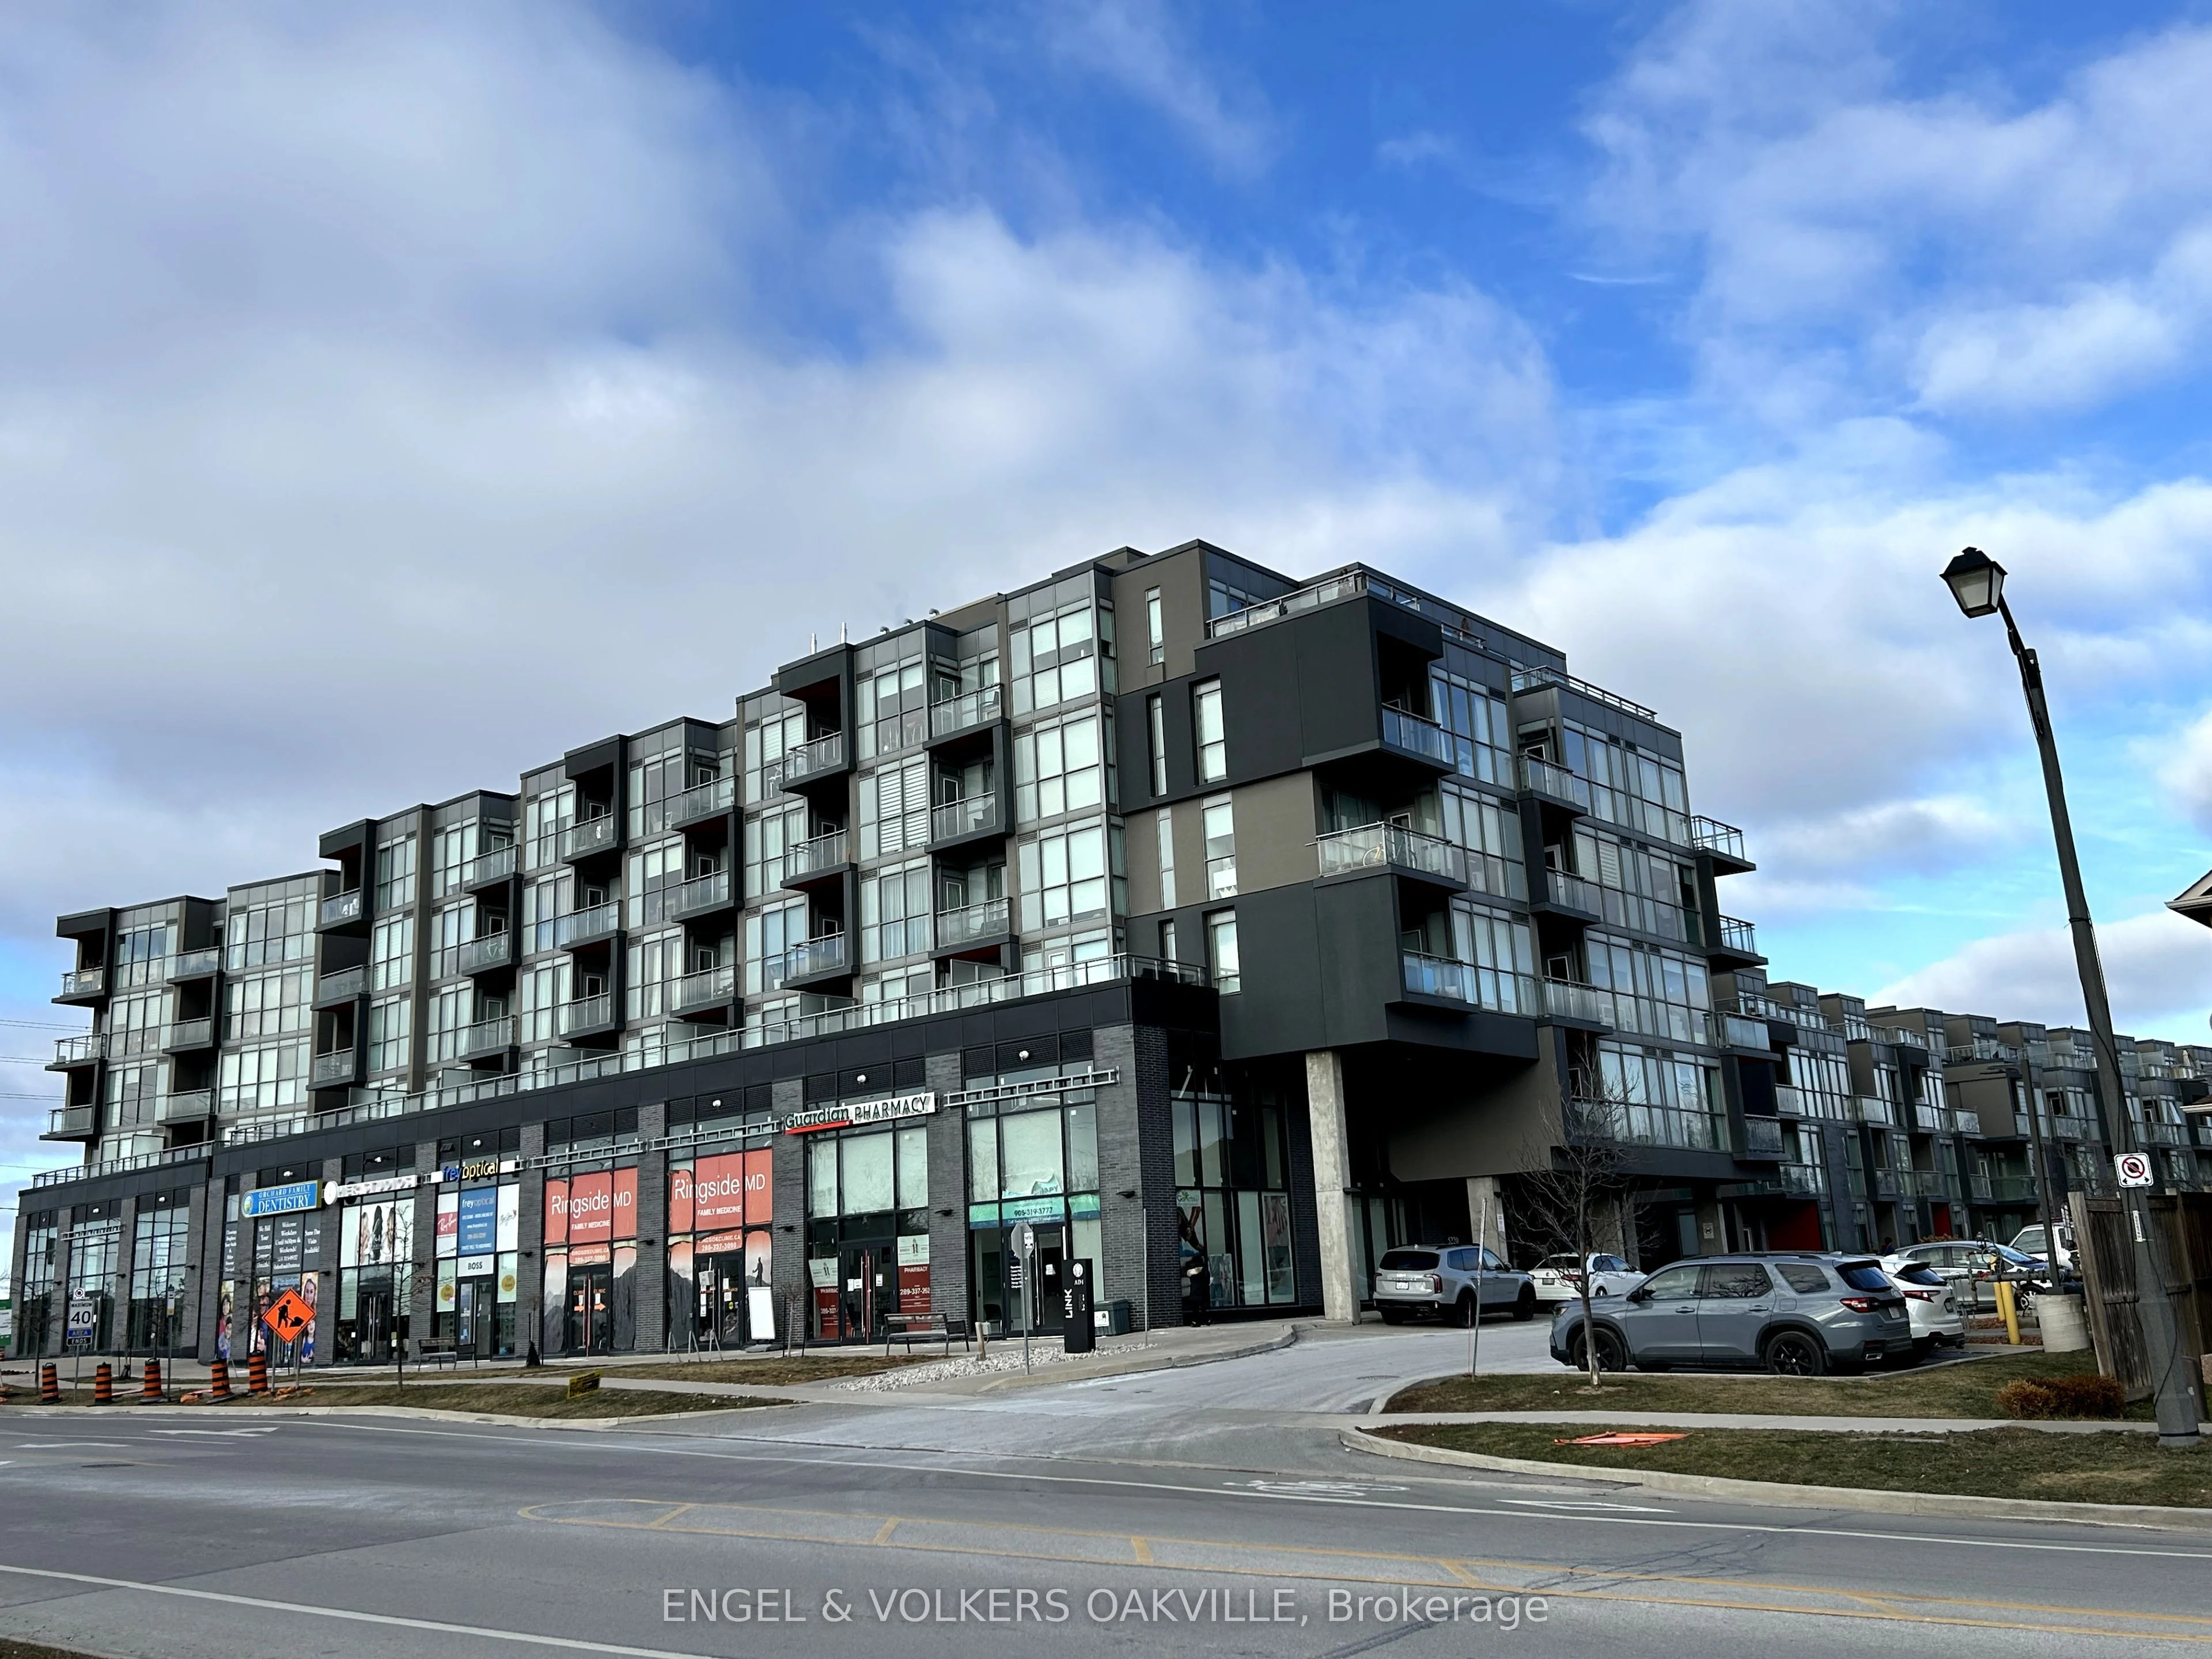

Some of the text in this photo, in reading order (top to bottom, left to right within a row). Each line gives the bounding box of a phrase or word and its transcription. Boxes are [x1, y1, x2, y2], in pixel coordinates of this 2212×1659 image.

[785, 1096, 929, 1128] Guardian PHARMACY
[258, 1184, 311, 1198] ORCHARD FAMILY
[675, 1173, 766, 1204] Ringside MD
[257, 1194, 310, 1213] DENTISTRY
[551, 1189, 632, 1219] Ringside MD
[697, 1205, 741, 1217] FAMILY MEDICINE
[571, 1219, 611, 1230] FAMILY MEDICINE
[468, 1262, 483, 1270] BOSS
[1064, 1289, 1073, 1319] LINK
[70, 1310, 91, 1324] 40
[71, 1337, 88, 1345] ENDS
